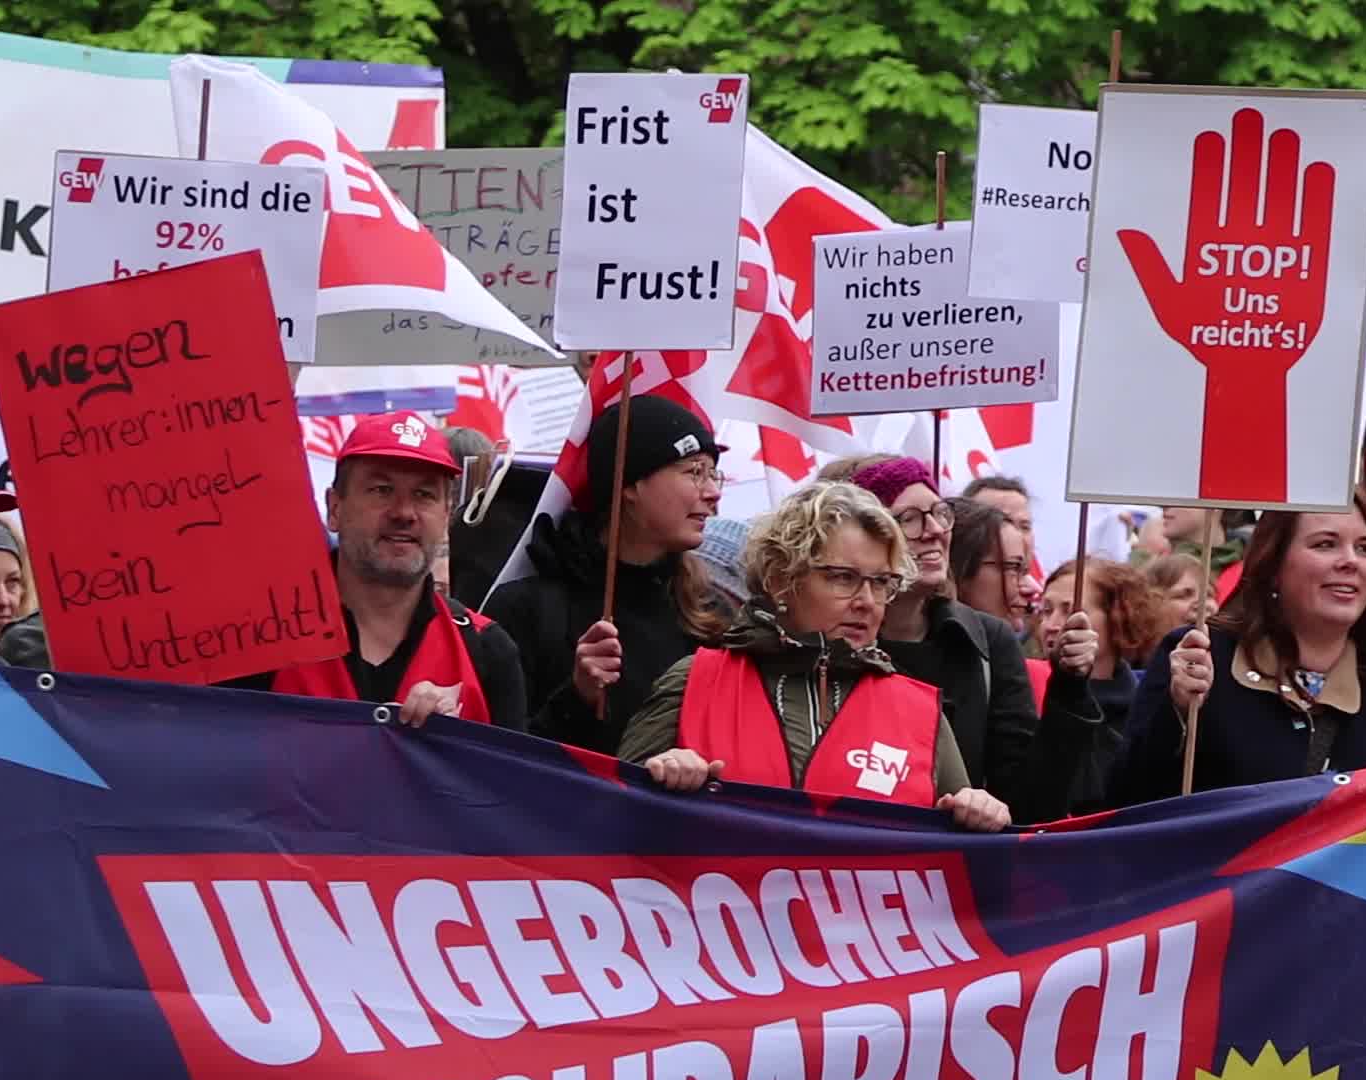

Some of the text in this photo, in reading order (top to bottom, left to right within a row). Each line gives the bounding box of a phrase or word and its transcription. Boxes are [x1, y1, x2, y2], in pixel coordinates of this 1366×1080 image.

[699, 92, 741, 109] GEW
[577, 106, 669, 144] Frist
[1048, 142, 1092, 170] No
[59, 171, 311, 213] GEW Wir sind die
[588, 184, 637, 222] ist
[982, 187, 1090, 211] #Research
[155, 221, 224, 251] 92%
[824, 244, 954, 269] Wir haben
[1198, 243, 1310, 279] STOP!
[596, 261, 719, 300] Frust!
[845, 277, 921, 299] nichts
[866, 303, 1023, 329] zu verlieren,
[1225, 288, 1279, 314] Uns
[383, 313, 428, 333] das
[828, 337, 994, 362] außer unsere
[820, 358, 1045, 393] Kettenbefristung!
[28, 391, 283, 463] Lehrer:innen-
[392, 422, 428, 441] GEW
[97, 570, 335, 672] Unterricht!
[847, 749, 910, 782] GEW
[143, 868, 980, 1066] UNGEBROCHEN
